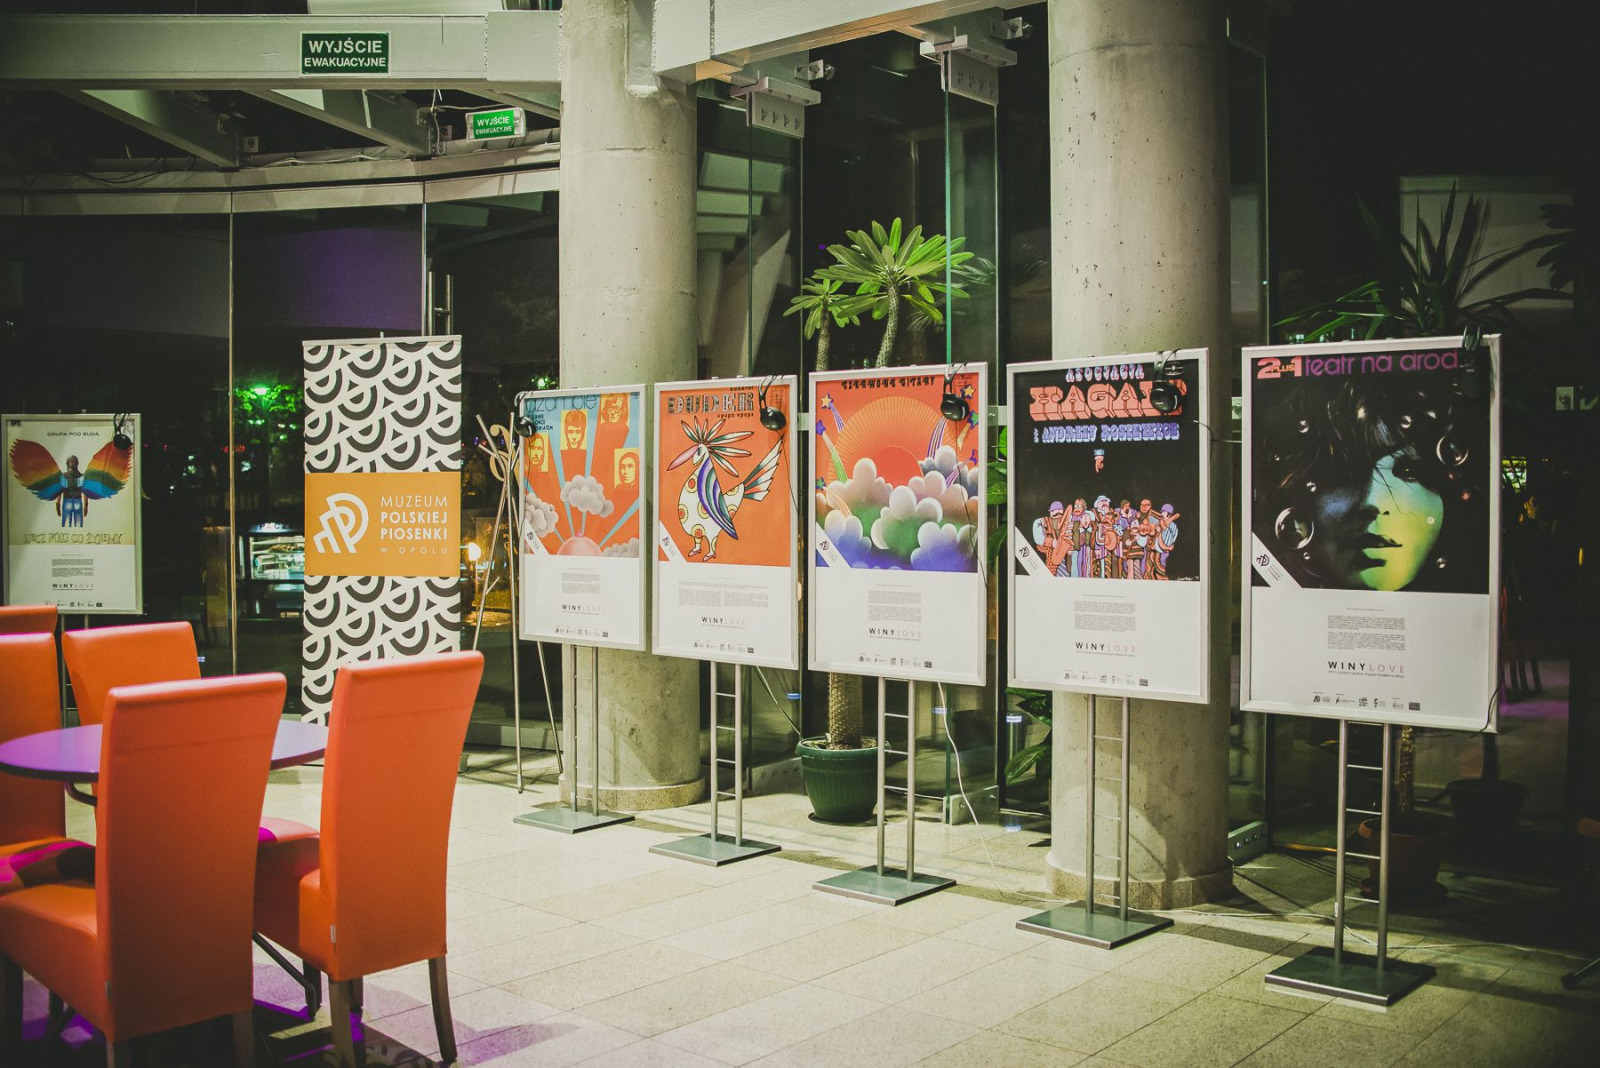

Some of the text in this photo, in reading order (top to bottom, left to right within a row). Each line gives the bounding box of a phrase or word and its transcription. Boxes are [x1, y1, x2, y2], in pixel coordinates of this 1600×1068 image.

[308, 37, 383, 53] WYJŚCIE
[304, 57, 386, 67] EWAKUACYJNE
[477, 115, 510, 127] WYJŚCIE
[1305, 354, 1355, 377] teatr
[1361, 354, 1393, 374] na
[381, 496, 448, 508] MUZEUM
[381, 511, 448, 524] POLSKIEJ
[381, 527, 448, 540] PIOSENKI
[1075, 641, 1136, 654] WINYLOVE
[1328, 660, 1406, 674] WINYLOVE
